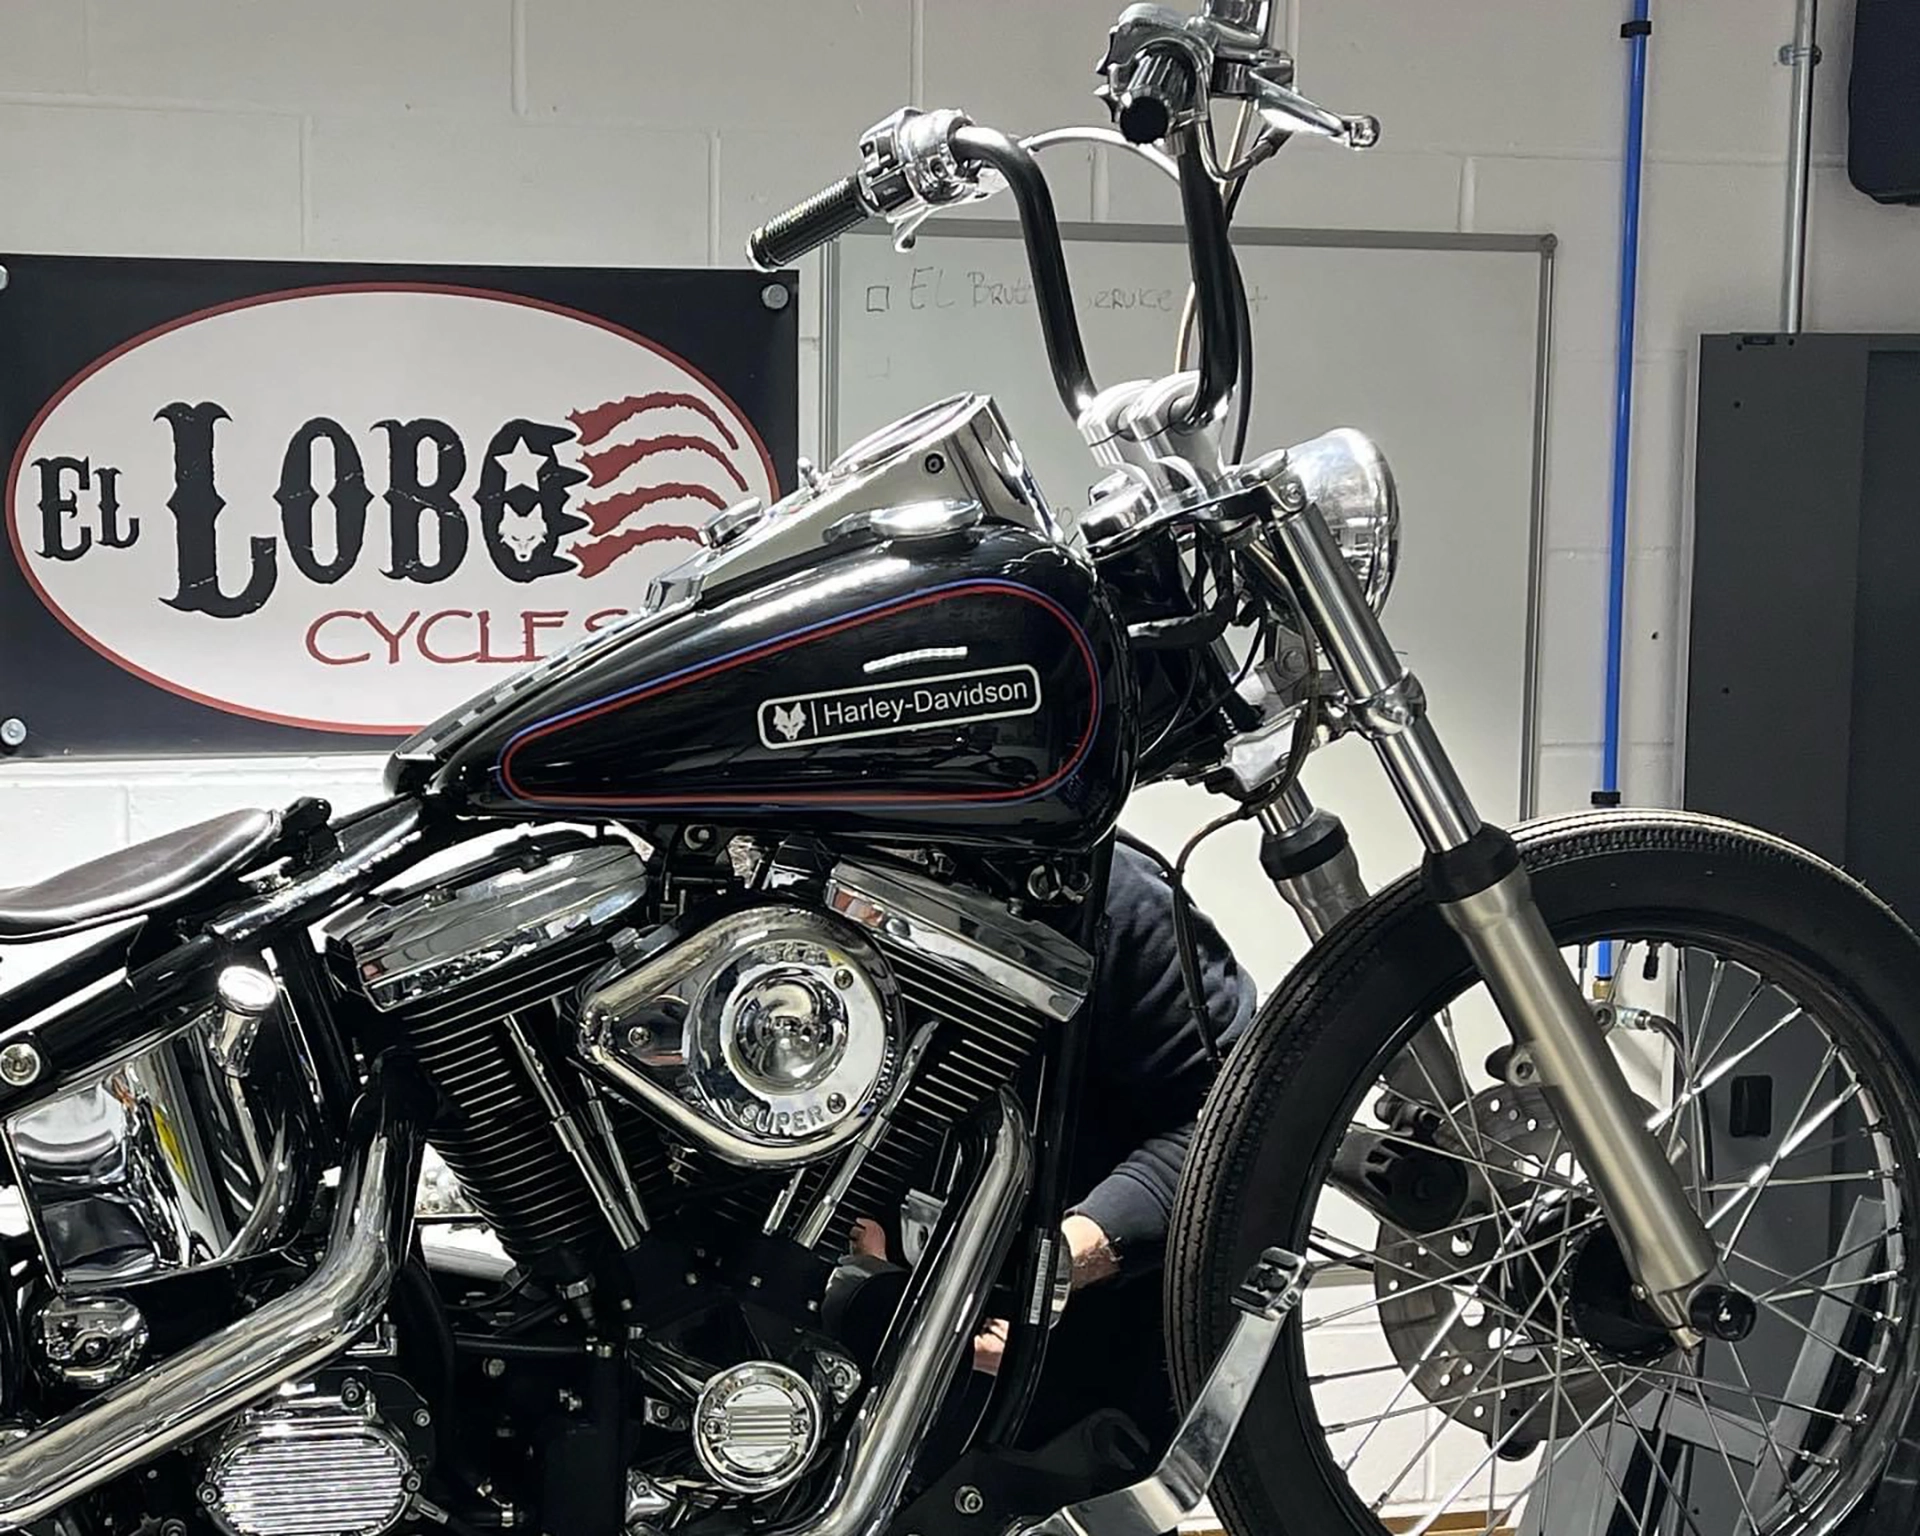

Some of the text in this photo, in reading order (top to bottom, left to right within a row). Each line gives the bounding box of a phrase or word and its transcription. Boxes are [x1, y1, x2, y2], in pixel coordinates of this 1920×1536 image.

[30, 400, 590, 619] EL LOBO
[823, 681, 1028, 726] Harley-Davidson
[740, 1103, 824, 1137] SUPER
